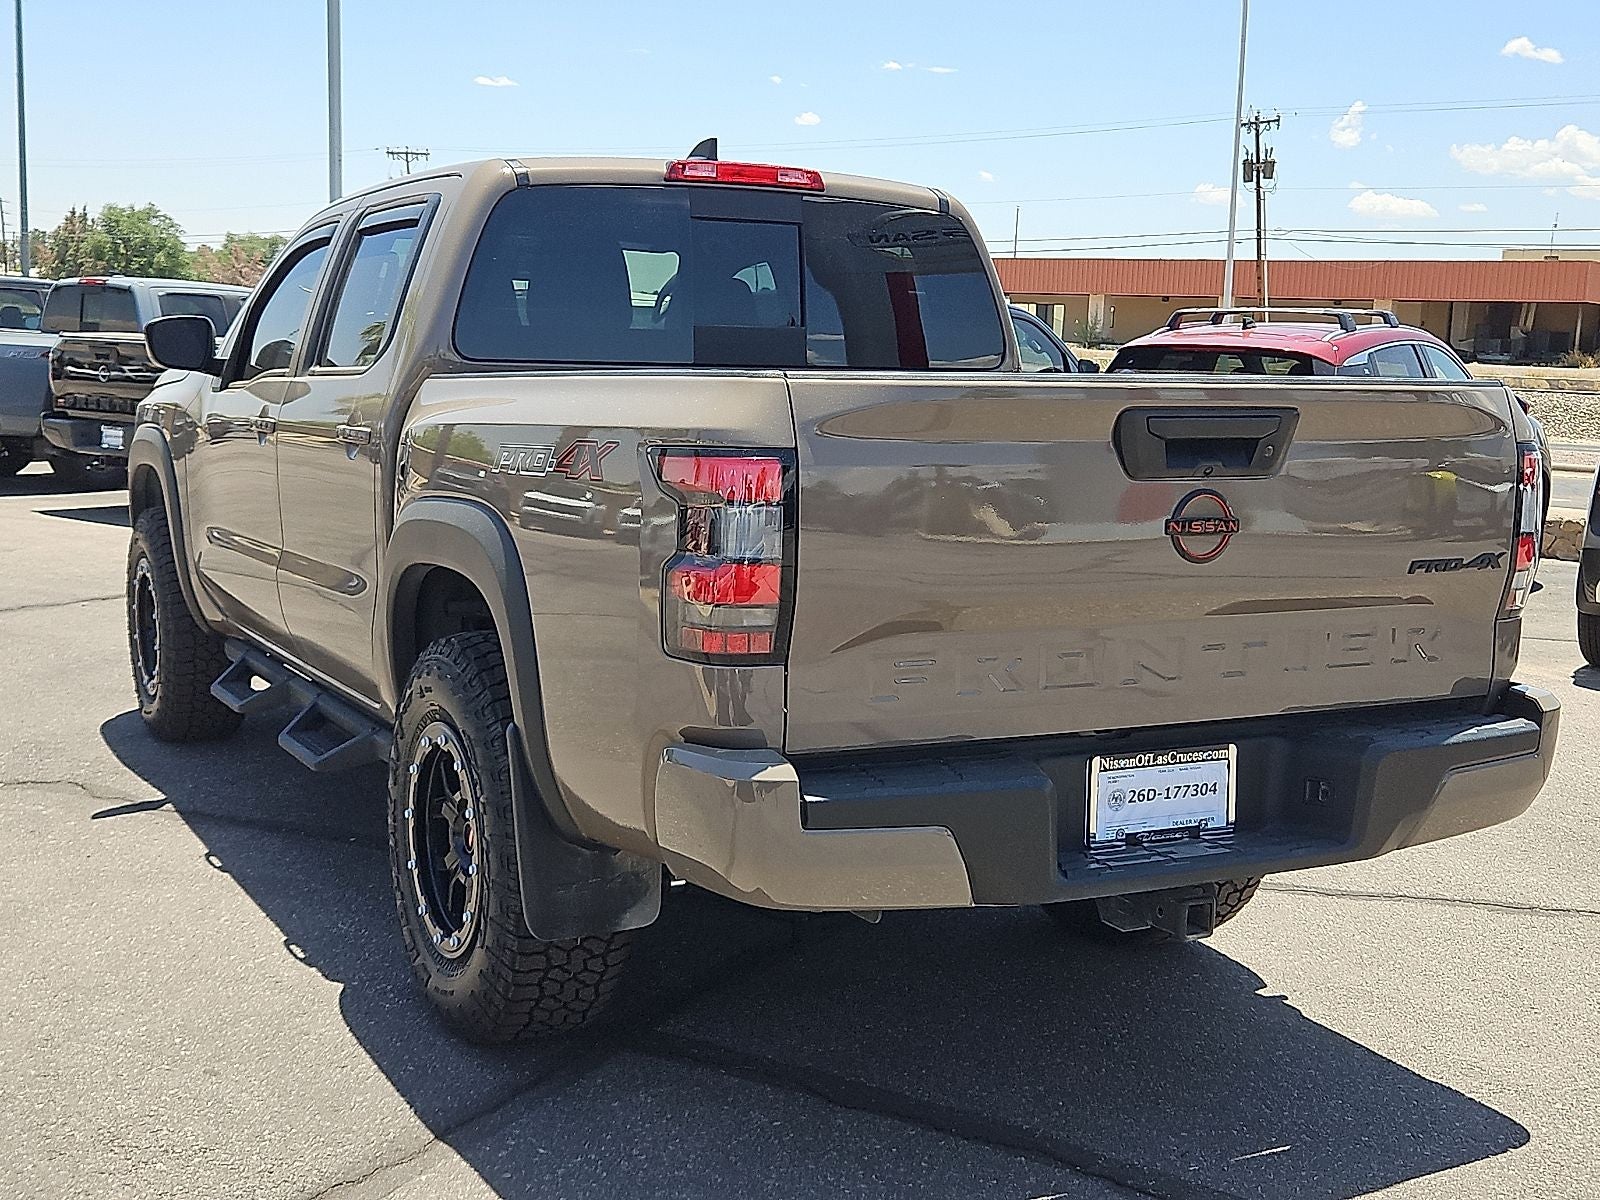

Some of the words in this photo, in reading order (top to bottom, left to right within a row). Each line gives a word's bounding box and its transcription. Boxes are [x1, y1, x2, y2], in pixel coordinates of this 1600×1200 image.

[491, 439, 619, 481] PRO-4X
[1169, 520, 1238, 533] NISSAN
[1407, 552, 1507, 574] PRO-4X
[870, 627, 1442, 703] FRONTIER
[1100, 749, 1229, 770] NisanOfLasCrucescom
[1127, 782, 1218, 804] 26D-177304
[1172, 818, 1193, 827] DEALER
